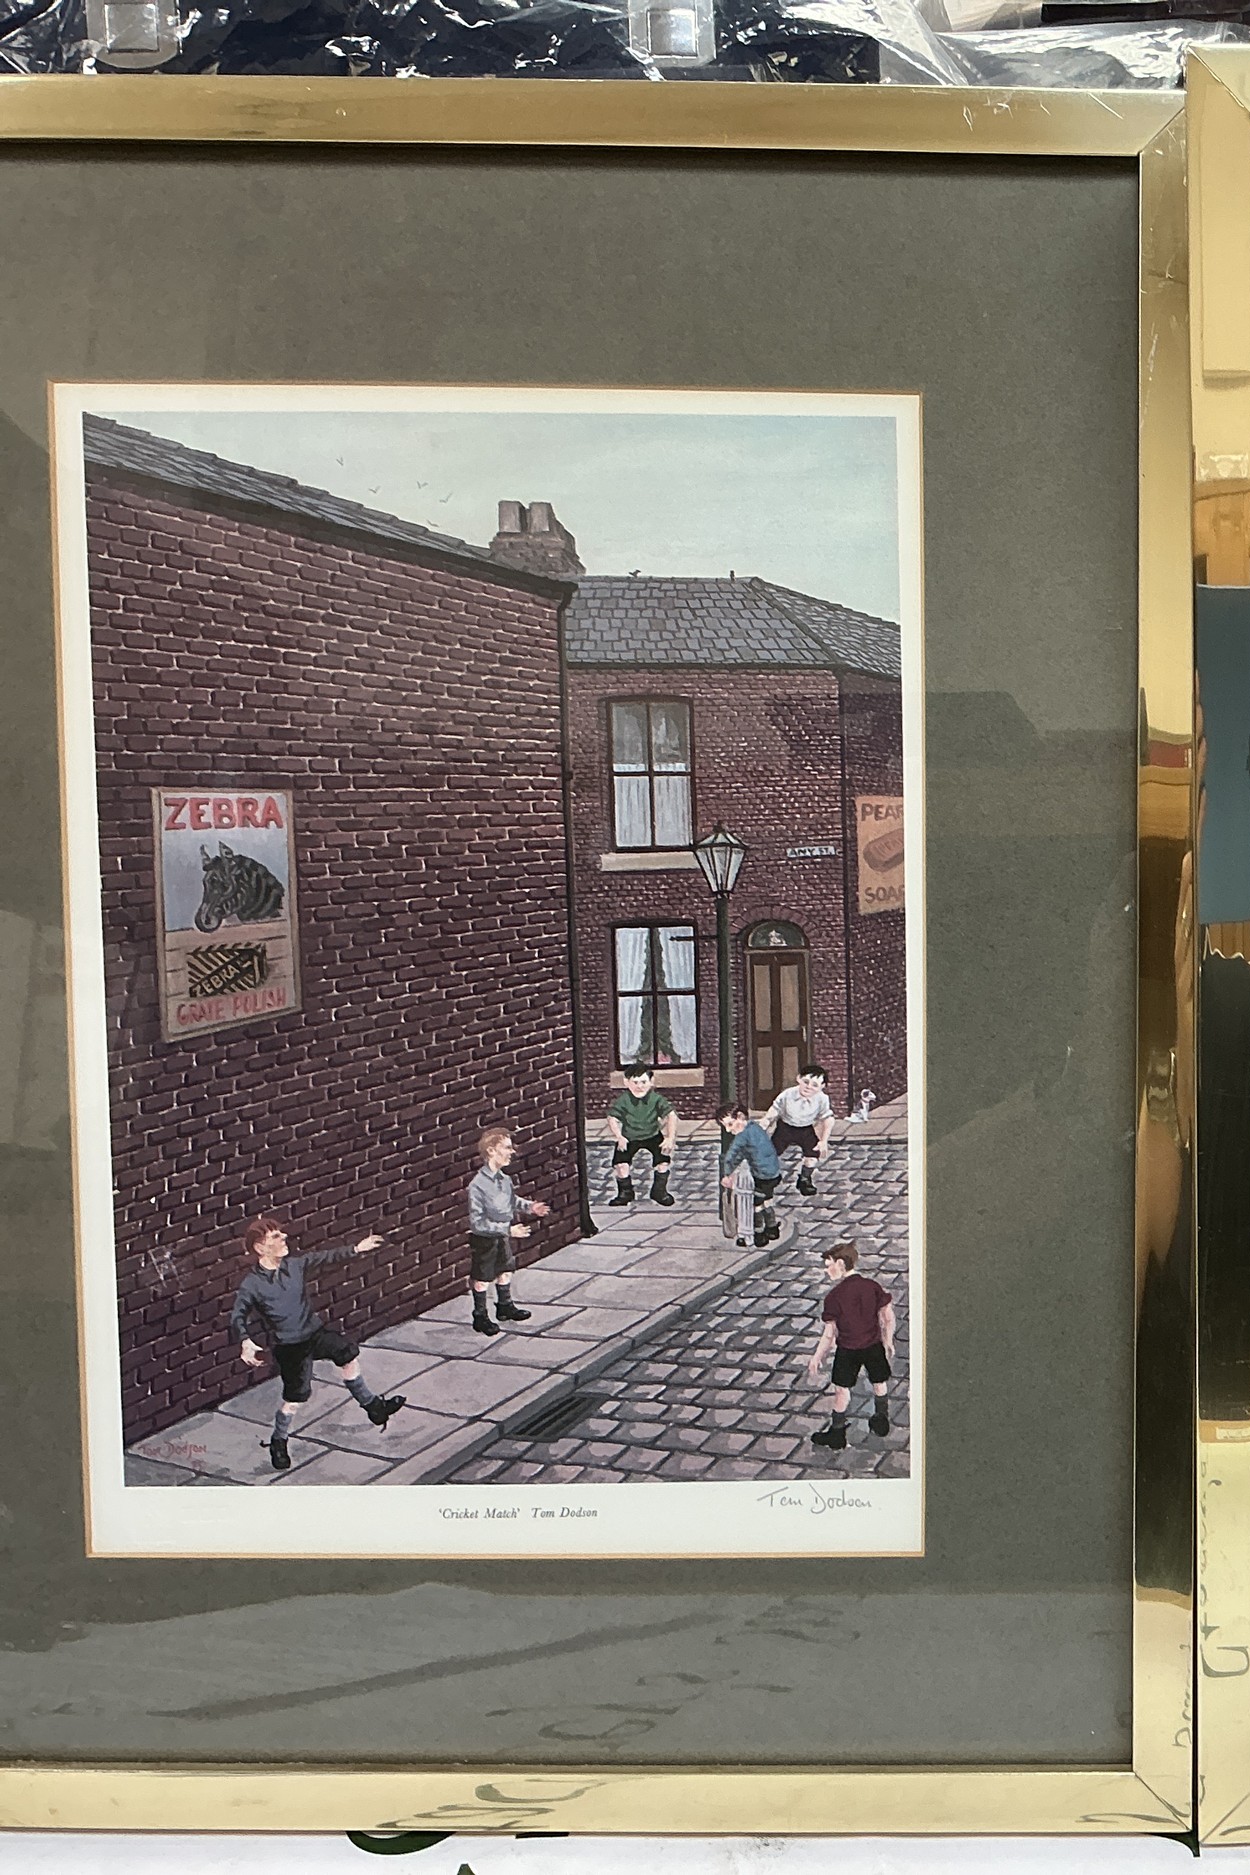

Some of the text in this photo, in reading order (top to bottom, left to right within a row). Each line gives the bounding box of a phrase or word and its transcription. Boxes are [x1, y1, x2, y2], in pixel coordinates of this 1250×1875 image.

[164, 796, 284, 831] ZEBRA
[531, 1507, 555, 1519] Tom
[559, 1506, 598, 1518] Dodson
